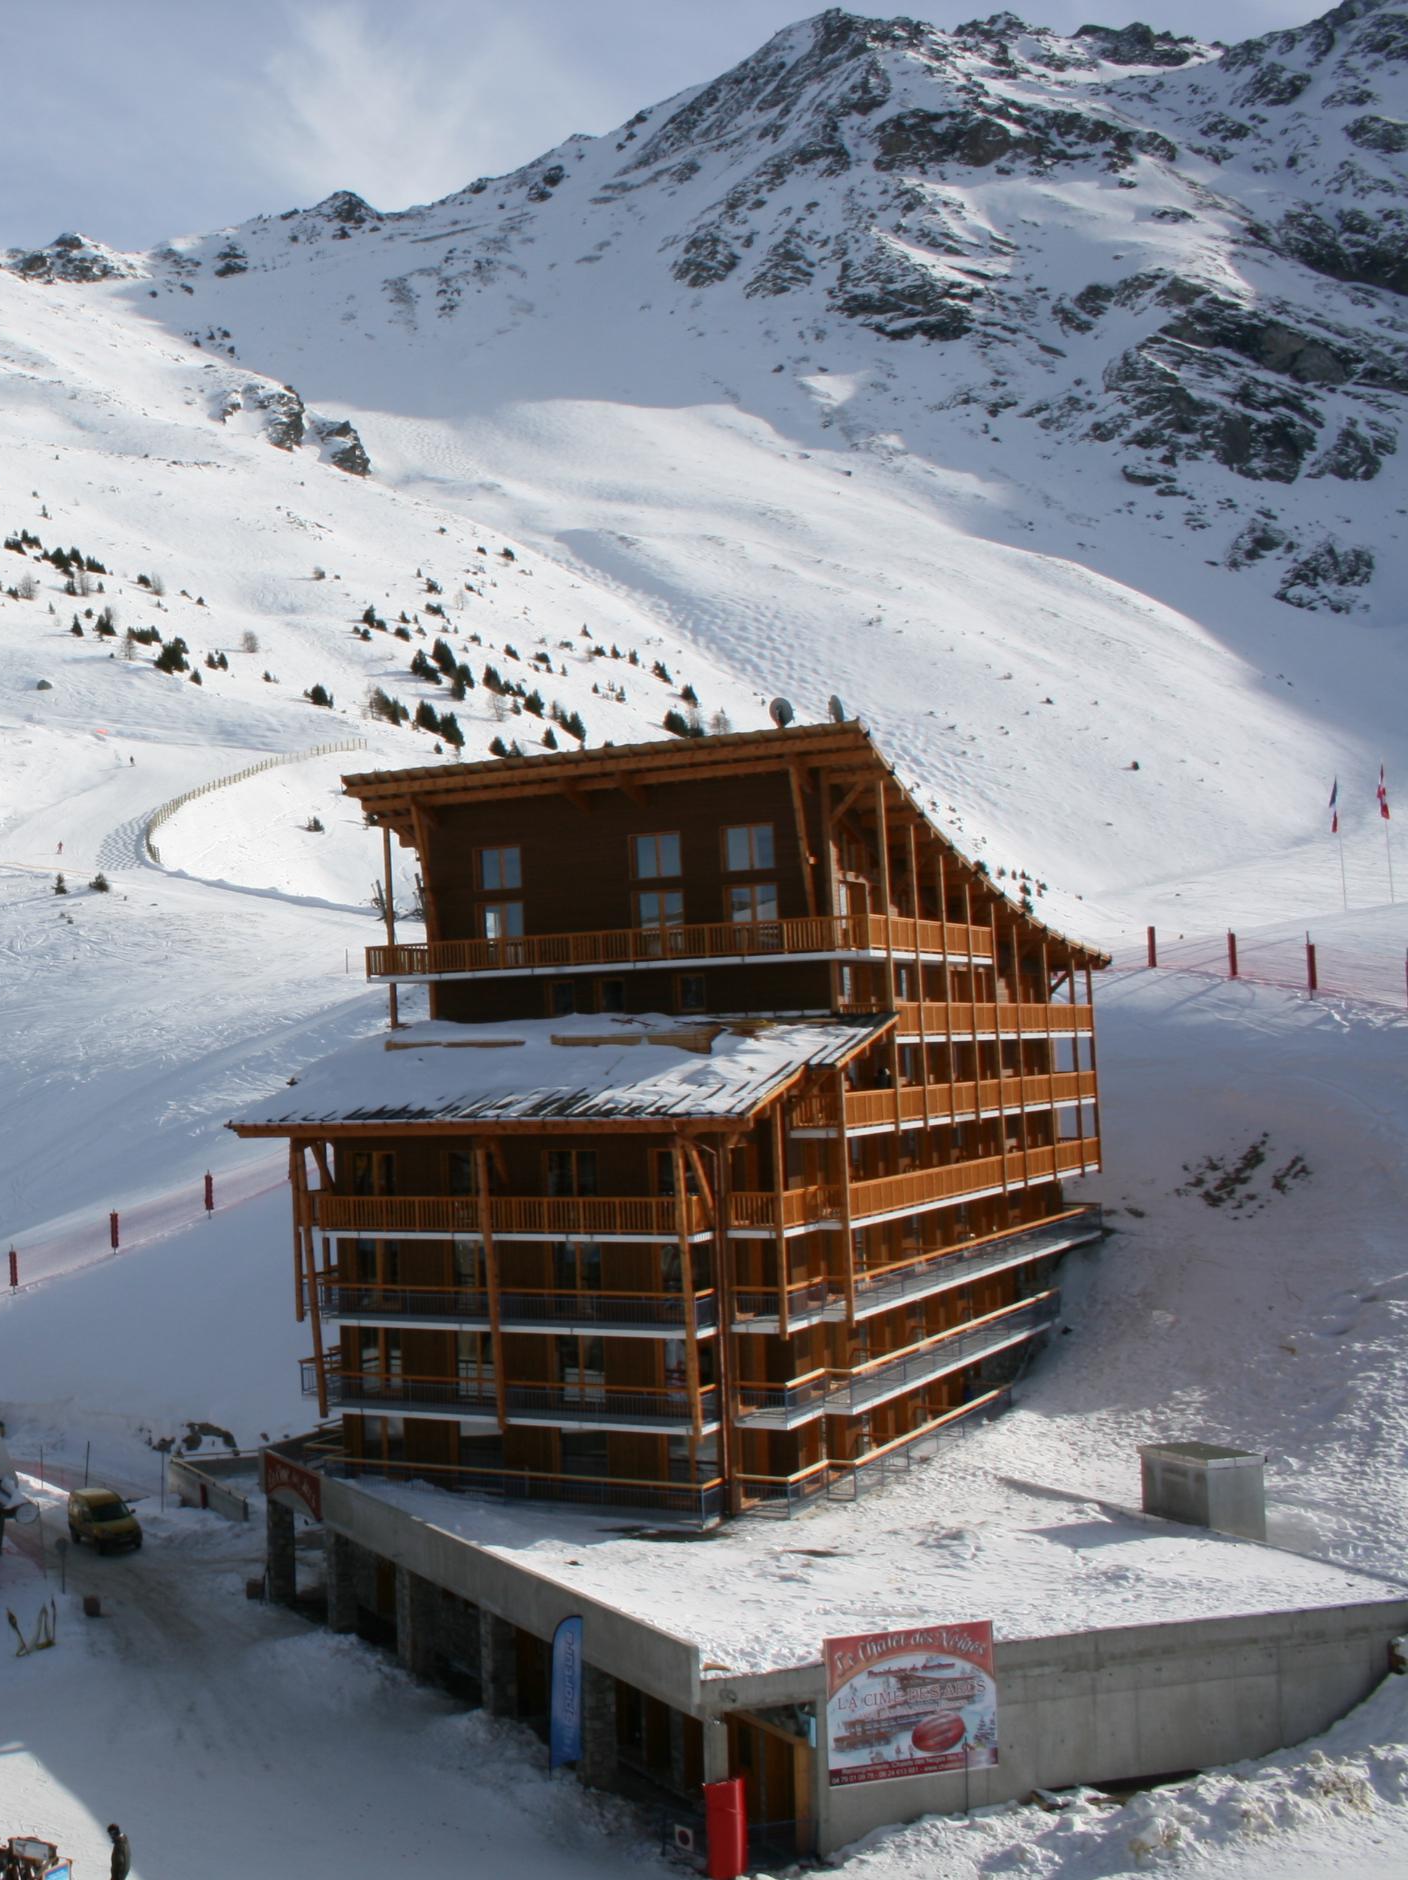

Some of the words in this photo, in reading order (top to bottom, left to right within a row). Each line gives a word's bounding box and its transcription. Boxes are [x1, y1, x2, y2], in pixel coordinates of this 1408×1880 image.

[858, 1631, 906, 1662] Chalet
[910, 1629, 934, 1645] des
[942, 1628, 986, 1656] Neiges
[837, 1696, 858, 1711] LA
[863, 1688, 905, 1707] CIME
[907, 1684, 941, 1703] DES
[942, 1679, 987, 1698] ARCS
